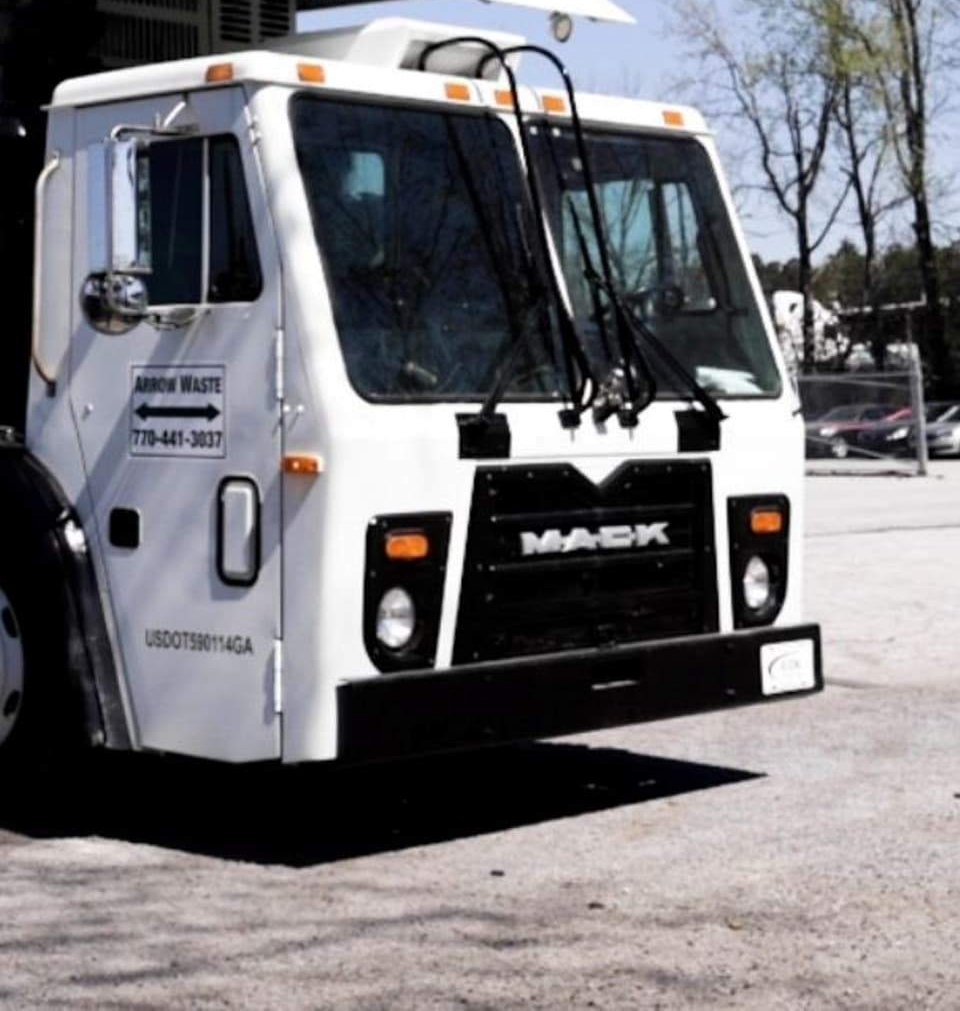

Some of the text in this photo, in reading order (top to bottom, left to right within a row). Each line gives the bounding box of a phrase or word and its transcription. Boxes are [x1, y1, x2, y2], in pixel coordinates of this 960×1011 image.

[134, 374, 222, 394] ARROW WASTE
[131, 428, 223, 449] 770-441-3037
[520, 521, 670, 556] MACK
